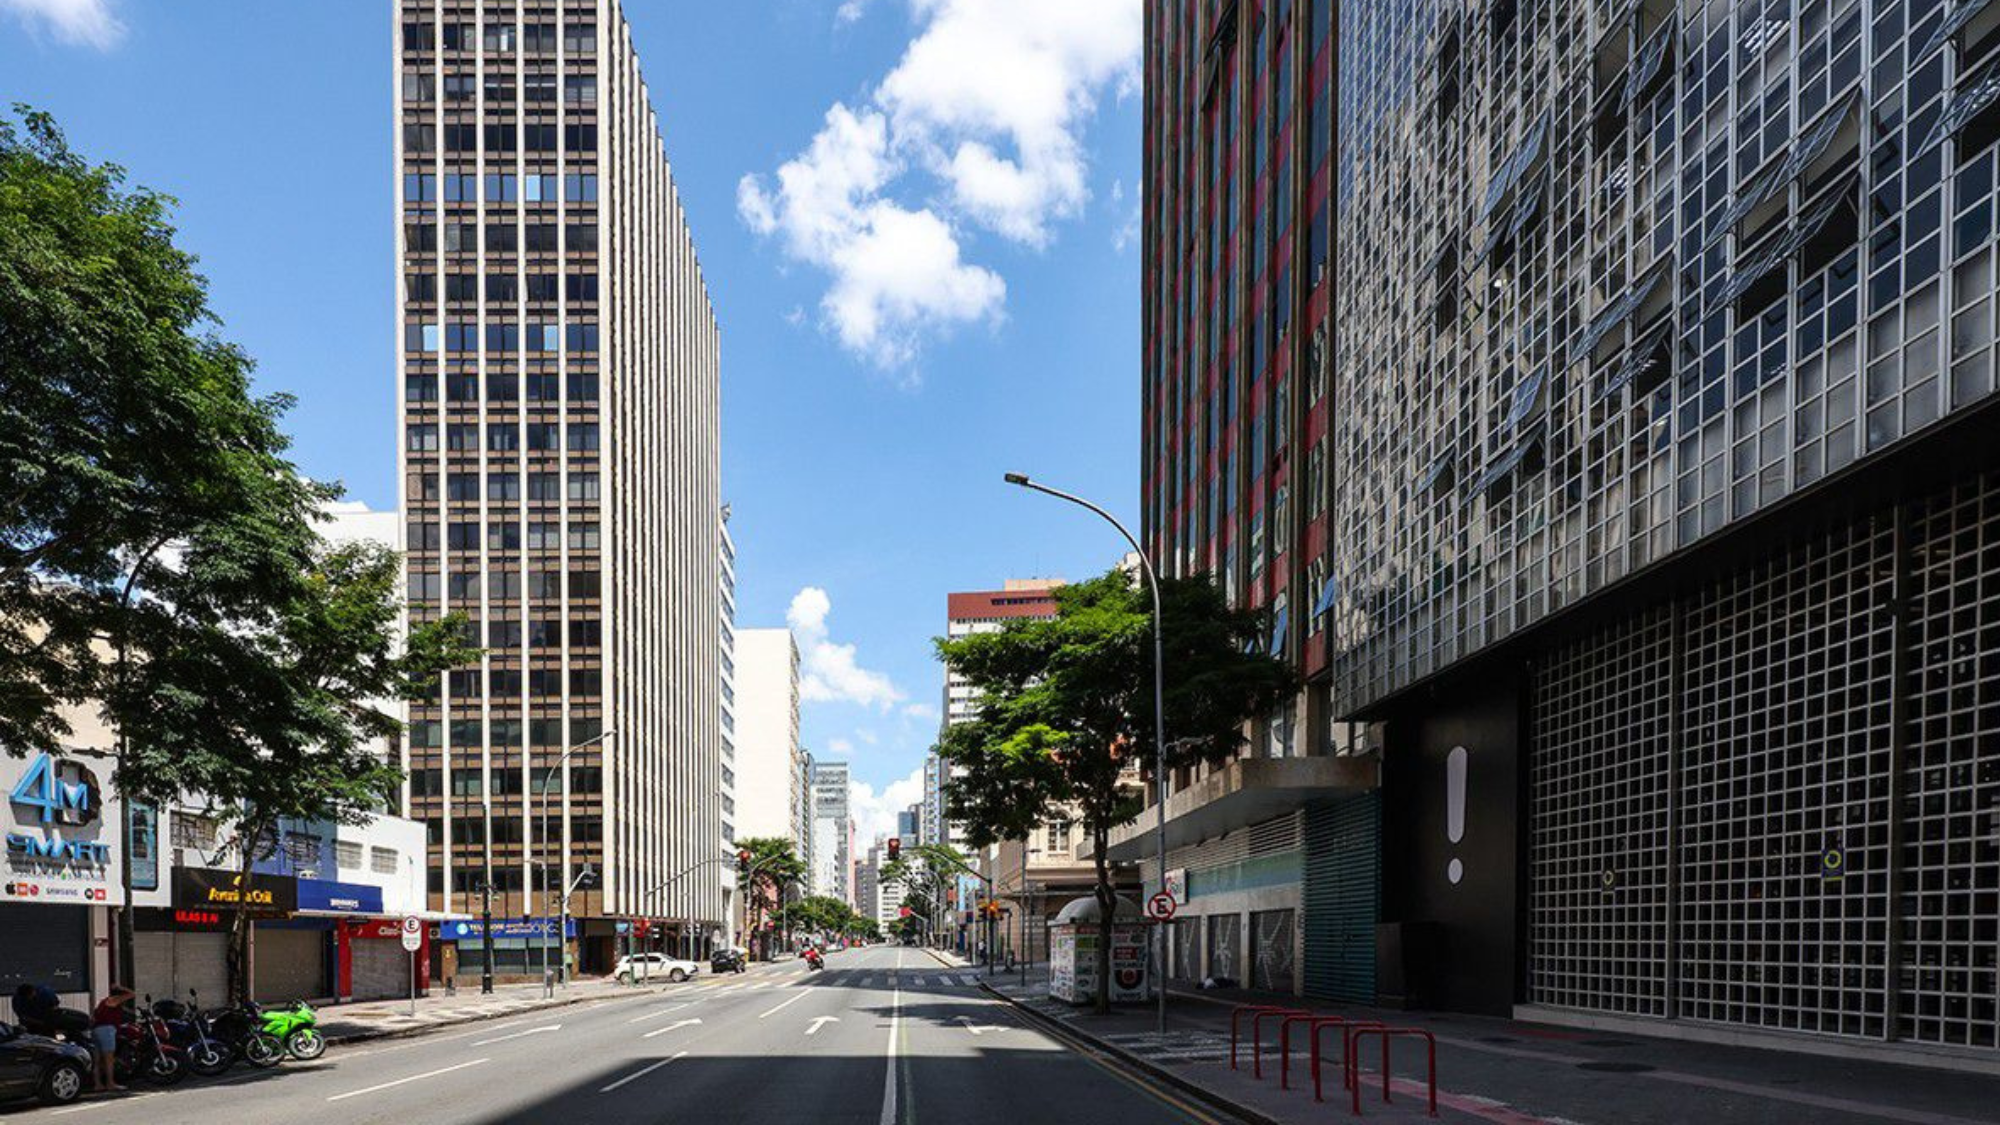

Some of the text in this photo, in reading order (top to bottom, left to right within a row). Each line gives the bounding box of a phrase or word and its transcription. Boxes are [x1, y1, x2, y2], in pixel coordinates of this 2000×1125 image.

[6, 832, 111, 865] SMART
[1156, 897, 1168, 914] E
[407, 919, 416, 930] E
